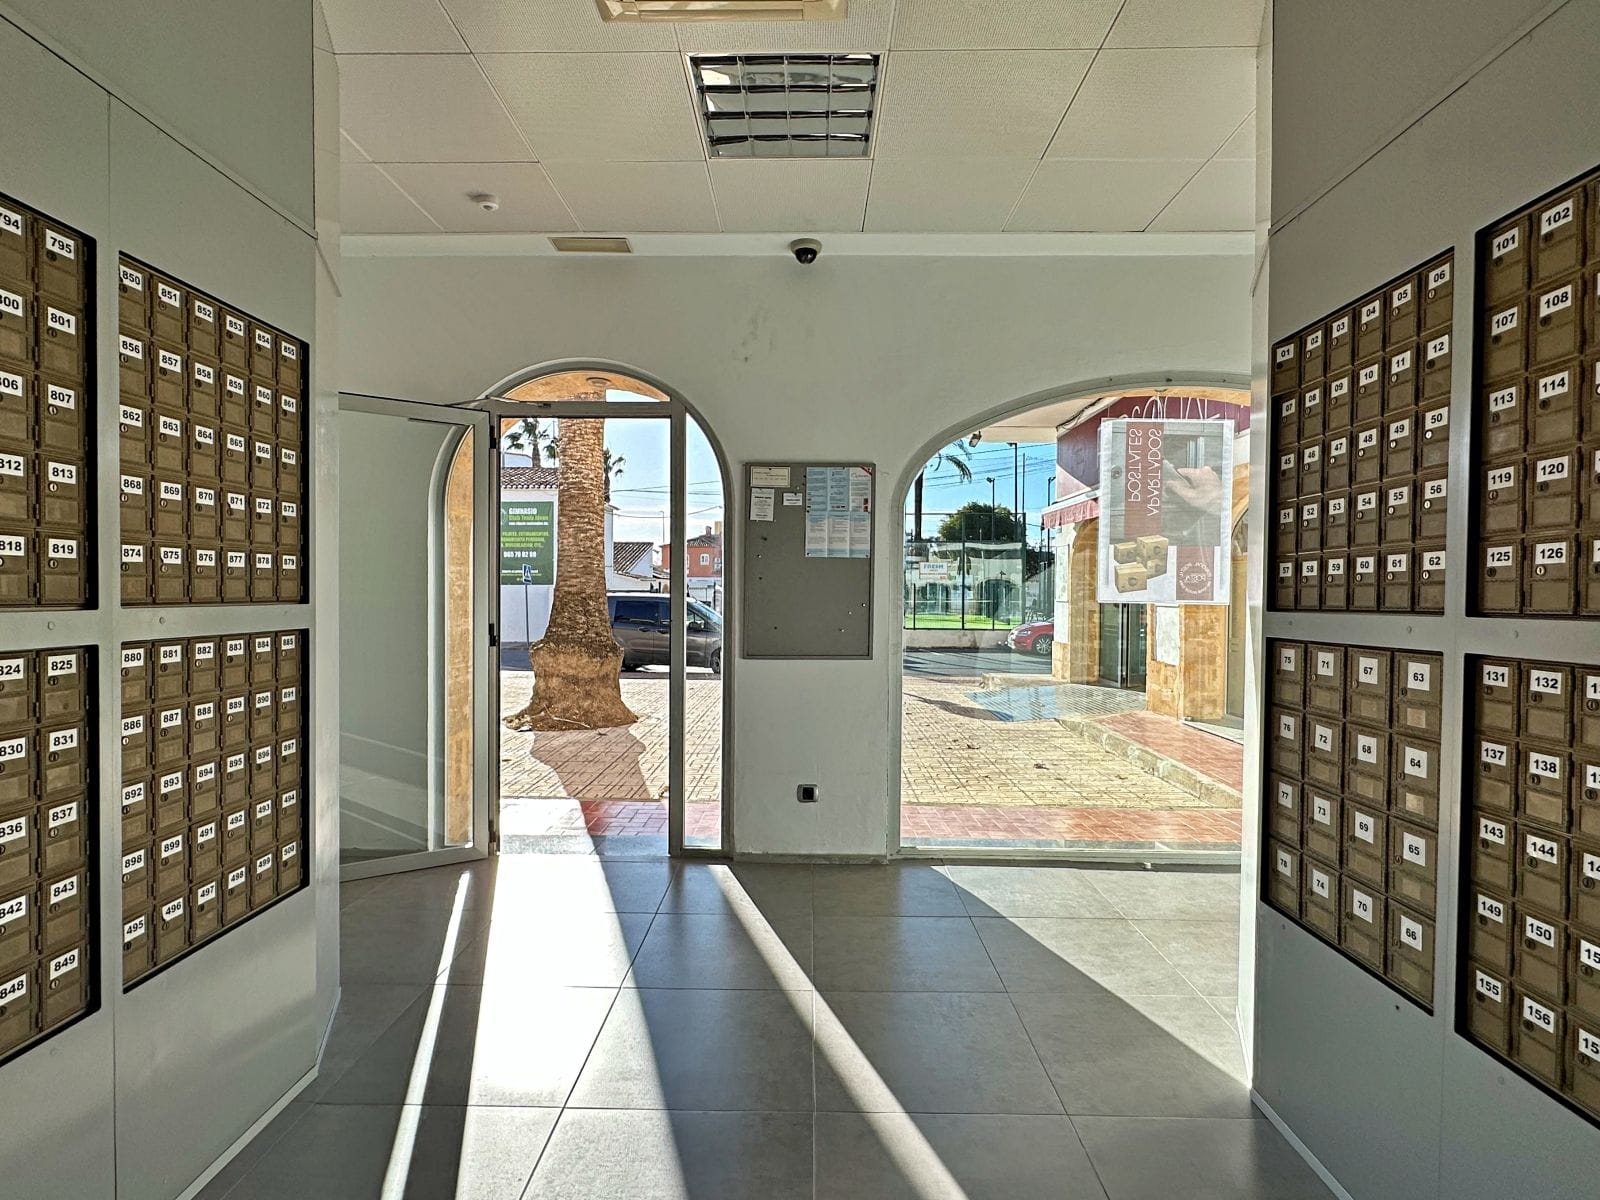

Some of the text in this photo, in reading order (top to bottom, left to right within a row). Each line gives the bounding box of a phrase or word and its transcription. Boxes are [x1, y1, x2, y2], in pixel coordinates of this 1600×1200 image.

[0, 212, 20, 230] 94
[1545, 207, 1570, 226] 102
[50, 236, 72, 254] 795
[1496, 234, 1515, 252] 101
[122, 270, 140, 285] 850
[1433, 270, 1446, 283] 06
[161, 288, 177, 302] 851
[1397, 289, 1408, 301] 05
[1544, 291, 1569, 309] 108
[197, 305, 212, 318] 852
[1366, 306, 1376, 317] 04
[50, 313, 71, 328] 801
[229, 320, 242, 332] 853
[1495, 312, 1516, 329] 107
[1336, 322, 1345, 332] 03
[257, 333, 270, 344] 854
[1310, 335, 1319, 346] 02
[122, 340, 140, 354] 856
[1432, 341, 1444, 353] 12
[1281, 348, 1290, 358] 01
[161, 355, 178, 367] 857
[1396, 357, 1405, 368] 11
[197, 367, 211, 379] 858
[1364, 370, 1374, 380] 10
[0, 377, 18, 390] 06
[229, 379, 242, 390] 859
[1334, 382, 1343, 392] 09
[1542, 377, 1566, 393] 114
[50, 390, 72, 404] 807
[258, 389, 271, 400] 860
[1308, 393, 1317, 403] 08
[1493, 392, 1514, 406] 113
[1285, 403, 1293, 412] 07
[122, 409, 140, 422] 862
[1431, 413, 1443, 424] 50
[162, 420, 178, 432] 863
[1394, 424, 1405, 434] 49
[197, 429, 212, 440] 864
[1363, 434, 1373, 443] 48
[229, 437, 243, 448] 865
[1334, 442, 1343, 451] 47
[257, 445, 269, 455] 866
[1307, 450, 1316, 459] 46
[1284, 457, 1291, 465] 45
[52, 467, 73, 479] 813
[1541, 462, 1565, 476] 120
[1491, 472, 1512, 485] 119
[123, 479, 141, 490] 868
[1430, 484, 1442, 495] 56
[164, 485, 180, 496] 869
[198, 491, 213, 501] 870
[1393, 491, 1404, 501] 55
[230, 496, 243, 505] 871
[257, 501, 270, 510] 872
[1362, 497, 1372, 506] 54
[1307, 507, 1315, 516] 52
[1333, 502, 1341, 511] 53
[1283, 512, 1290, 520] 51
[0, 540, 22, 551] 818
[52, 543, 74, 554] 819
[123, 548, 141, 557] 874
[163, 550, 179, 560] 875
[198, 553, 213, 562] 876
[1490, 551, 1510, 562] 125
[1540, 547, 1563, 559] 126
[229, 555, 243, 563] 877
[257, 556, 270, 565] 878
[1392, 559, 1402, 568] 61
[1429, 556, 1441, 566] 62
[1282, 566, 1290, 574] 57
[1306, 565, 1314, 573] 58
[1332, 563, 1341, 571] 59
[1360, 561, 1370, 569] 60
[229, 643, 242, 652] 883
[257, 640, 269, 649] 884
[162, 649, 178, 659] 881
[197, 646, 211, 655] 882
[124, 652, 142, 662] 880
[1284, 656, 1292, 664] 75
[51, 660, 73, 671] 825
[1321, 660, 1329, 669] 71
[1363, 666, 1373, 675] 67
[1486, 670, 1505, 682] 131
[1413, 672, 1424, 682] 63
[1535, 676, 1558, 689] 132
[229, 700, 242, 710] 889
[257, 695, 269, 704] 890
[197, 706, 212, 716] 888
[163, 712, 179, 723] 887
[123, 719, 142, 730] 886
[1283, 723, 1291, 732] 76
[53, 734, 73, 746] 831
[1319, 734, 1328, 744] 72
[0, 743, 23, 757] 830
[258, 749, 270, 760] 896
[1362, 744, 1372, 754] 68
[1484, 747, 1504, 760] 137
[229, 757, 242, 768] 895
[1410, 758, 1421, 769] 64
[1534, 759, 1557, 773] 138
[198, 767, 213, 778] 894
[163, 776, 180, 788] 893
[124, 787, 142, 800] 892
[1281, 790, 1289, 799] 77
[258, 803, 270, 813] 493
[1318, 806, 1326, 816] 73
[52, 806, 73, 822] 837
[229, 814, 243, 825] 492
[199, 826, 213, 838] 491
[1359, 821, 1369, 832] 69
[1483, 824, 1503, 839] 143
[164, 839, 180, 853] 899
[1408, 844, 1420, 856] 65
[1531, 842, 1555, 858] 144
[124, 854, 142, 868] 898
[258, 857, 270, 868] 499
[1280, 858, 1287, 868] 78
[231, 870, 244, 882] 498
[53, 881, 75, 897] 843
[1316, 879, 1325, 890] 74
[200, 885, 214, 897] 497
[165, 901, 181, 915] 496
[1357, 900, 1368, 912] 70
[1481, 901, 1501, 917] 149
[126, 919, 144, 934] 495
[1528, 923, 1552, 941] 150
[1405, 928, 1417, 941] 66
[54, 954, 76, 972] 849
[0, 980, 24, 999] 848
[1479, 978, 1499, 996] 155
[1528, 1005, 1551, 1026] 156
